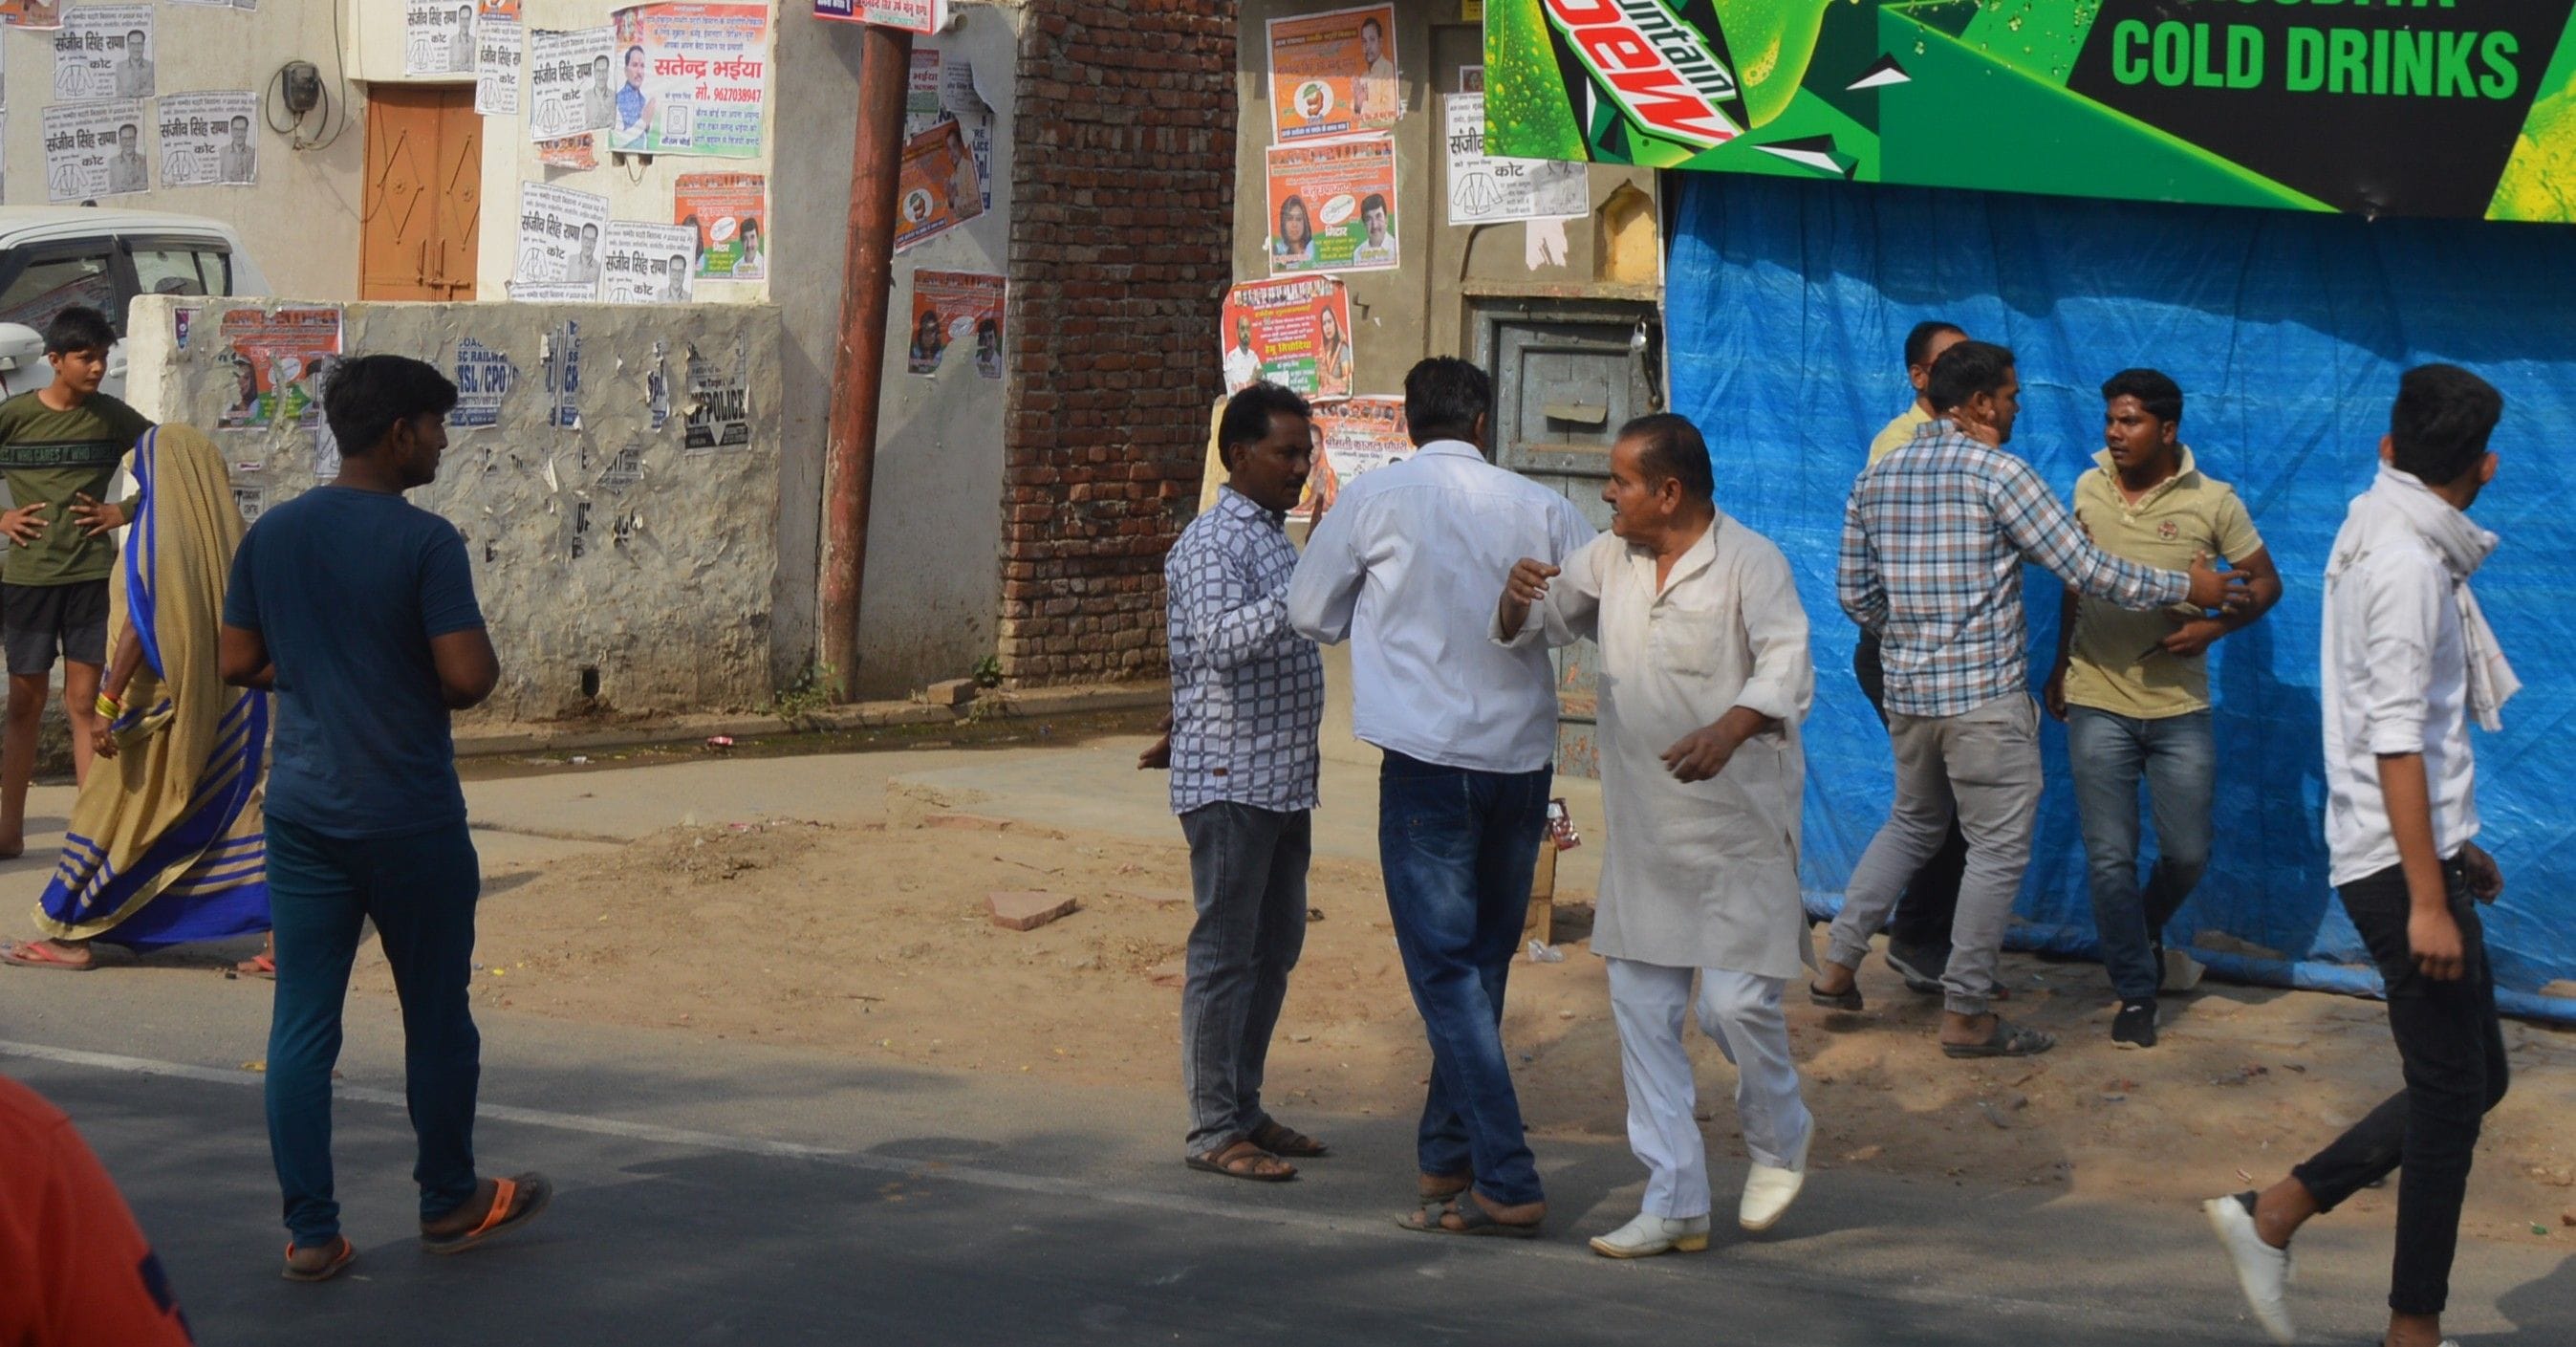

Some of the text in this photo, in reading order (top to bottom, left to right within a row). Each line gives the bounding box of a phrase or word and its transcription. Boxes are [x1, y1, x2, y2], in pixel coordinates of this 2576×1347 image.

[55, 32, 83, 52] संजीव
[85, 31, 103, 53] सिंह
[654, 54, 763, 80] सतेन्द्र भईया
[2112, 19, 2519, 99] COLD DRINKS
[532, 61, 557, 85] संजीव
[559, 59, 574, 82] सिंह
[713, 88, 762, 102] 9627038947
[160, 118, 188, 138] संजीव
[190, 116, 208, 137] सिंह
[46, 131, 75, 153] संजीव
[76, 128, 95, 149] सिंह
[1494, 162, 1525, 177] कोट
[521, 212, 545, 234] संजीव
[546, 213, 563, 239] सिंह
[606, 249, 630, 272] संजीव
[632, 250, 648, 276] सिंह
[705, 389, 746, 424] POLICE
[34, 448, 60, 462] CARES
[72, 447, 90, 460] WHO
